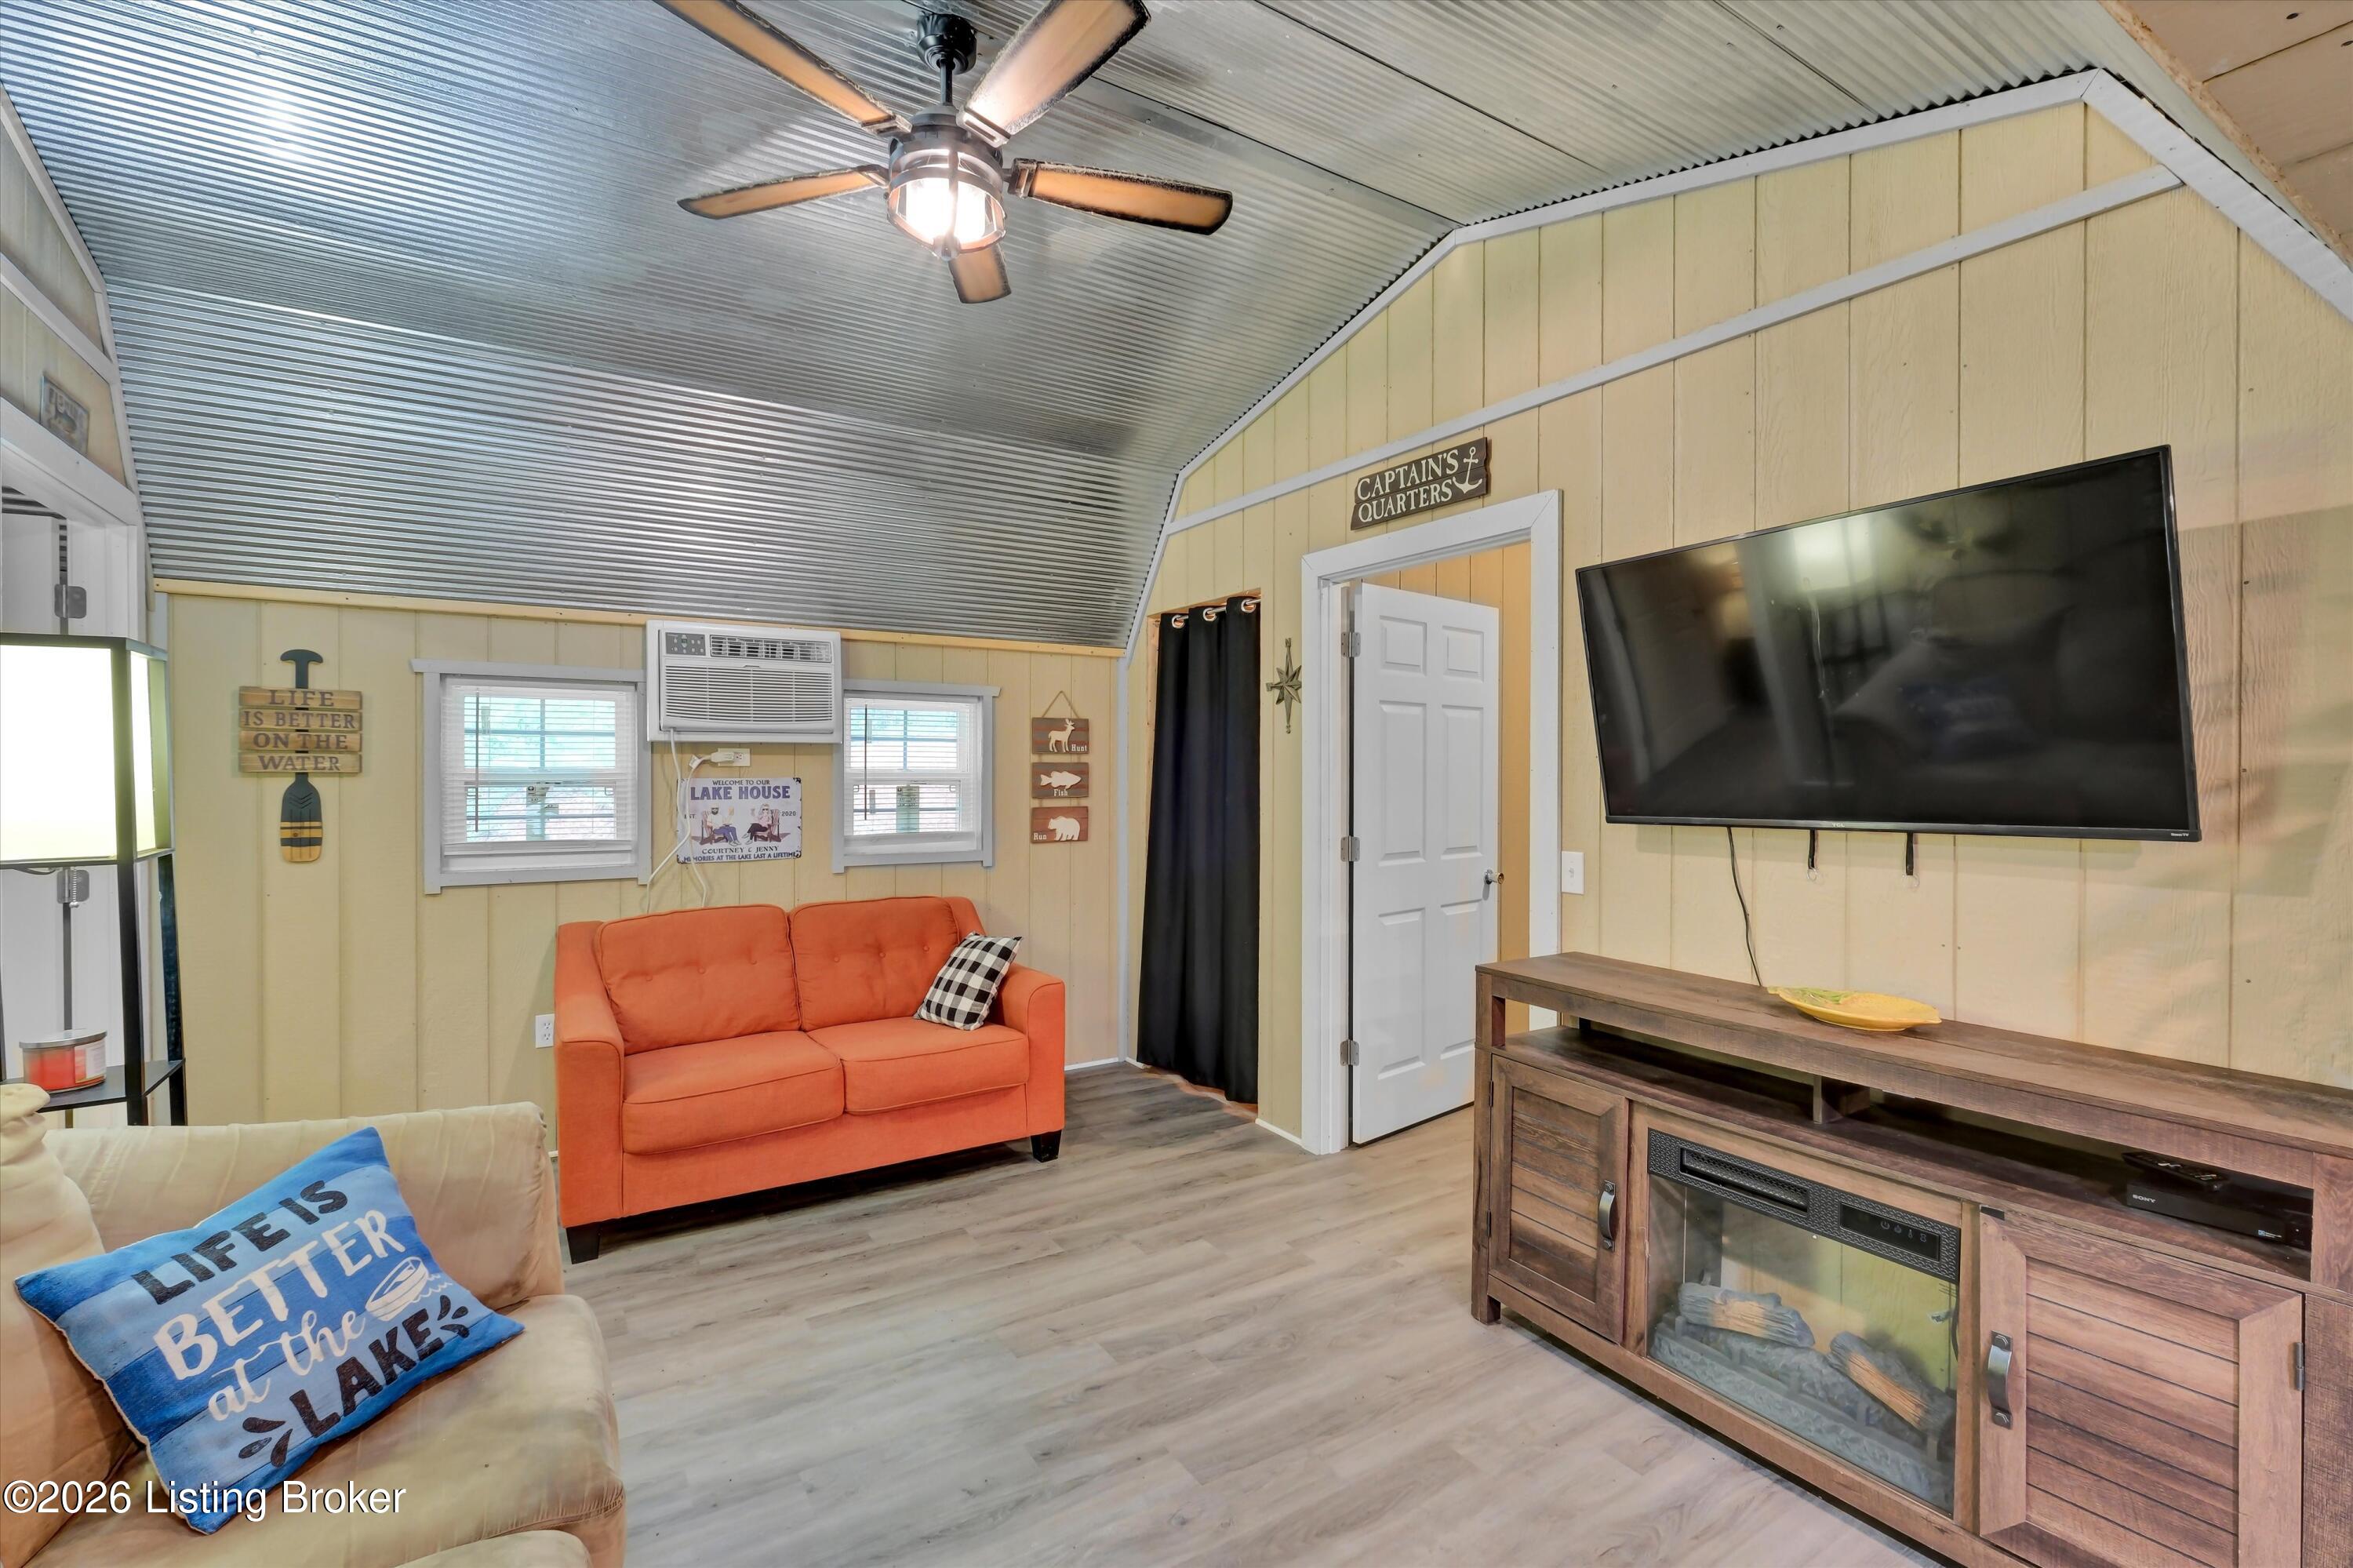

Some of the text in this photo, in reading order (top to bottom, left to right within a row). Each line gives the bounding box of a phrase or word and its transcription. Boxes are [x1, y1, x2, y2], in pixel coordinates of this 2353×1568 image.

[1357, 449, 1459, 500] CAPTAIN'S
[1358, 478, 1453, 522] QUARTERS
[269, 689, 335, 707] LIFE
[244, 711, 356, 729] IS BETTER
[253, 732, 348, 750] ON THE
[257, 755, 341, 771] WATER
[690, 785, 791, 801] LAKE HOUSE
[2133, 1194, 2155, 1203] SONY
[129, 1180, 348, 1305] LIFE IS
[153, 1210, 406, 1381] BETTER
[208, 1310, 366, 1421] at the
[289, 1308, 444, 1438] LAKE
